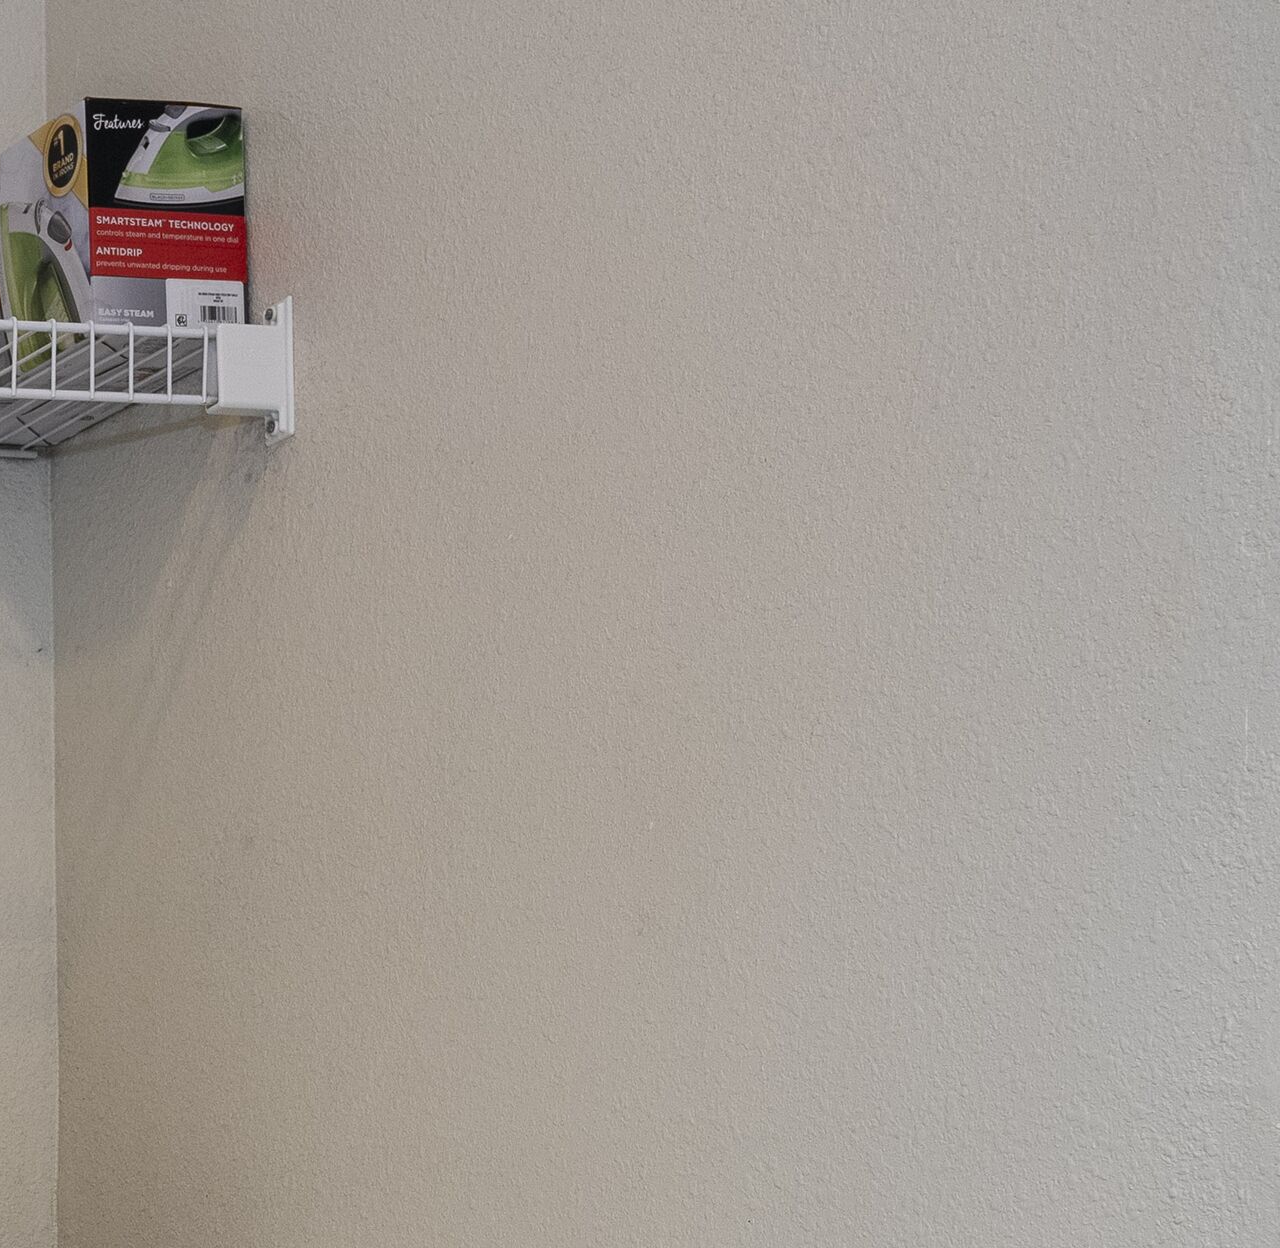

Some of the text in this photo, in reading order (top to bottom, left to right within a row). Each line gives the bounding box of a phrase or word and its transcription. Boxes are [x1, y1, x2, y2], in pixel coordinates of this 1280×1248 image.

[168, 219, 234, 232] TECHNOLOGY
[96, 229, 124, 237] controls
[125, 231, 147, 239] steam
[147, 231, 161, 239] and
[162, 233, 203, 243] temperature
[204, 234, 212, 242] in
[226, 236, 239, 244] dial
[96, 246, 143, 257] ANTIDRIP
[127, 262, 161, 270] unwanted
[162, 263, 191, 273] dripping
[192, 264, 215, 273] during
[98, 308, 155, 318] EASY STEAM
